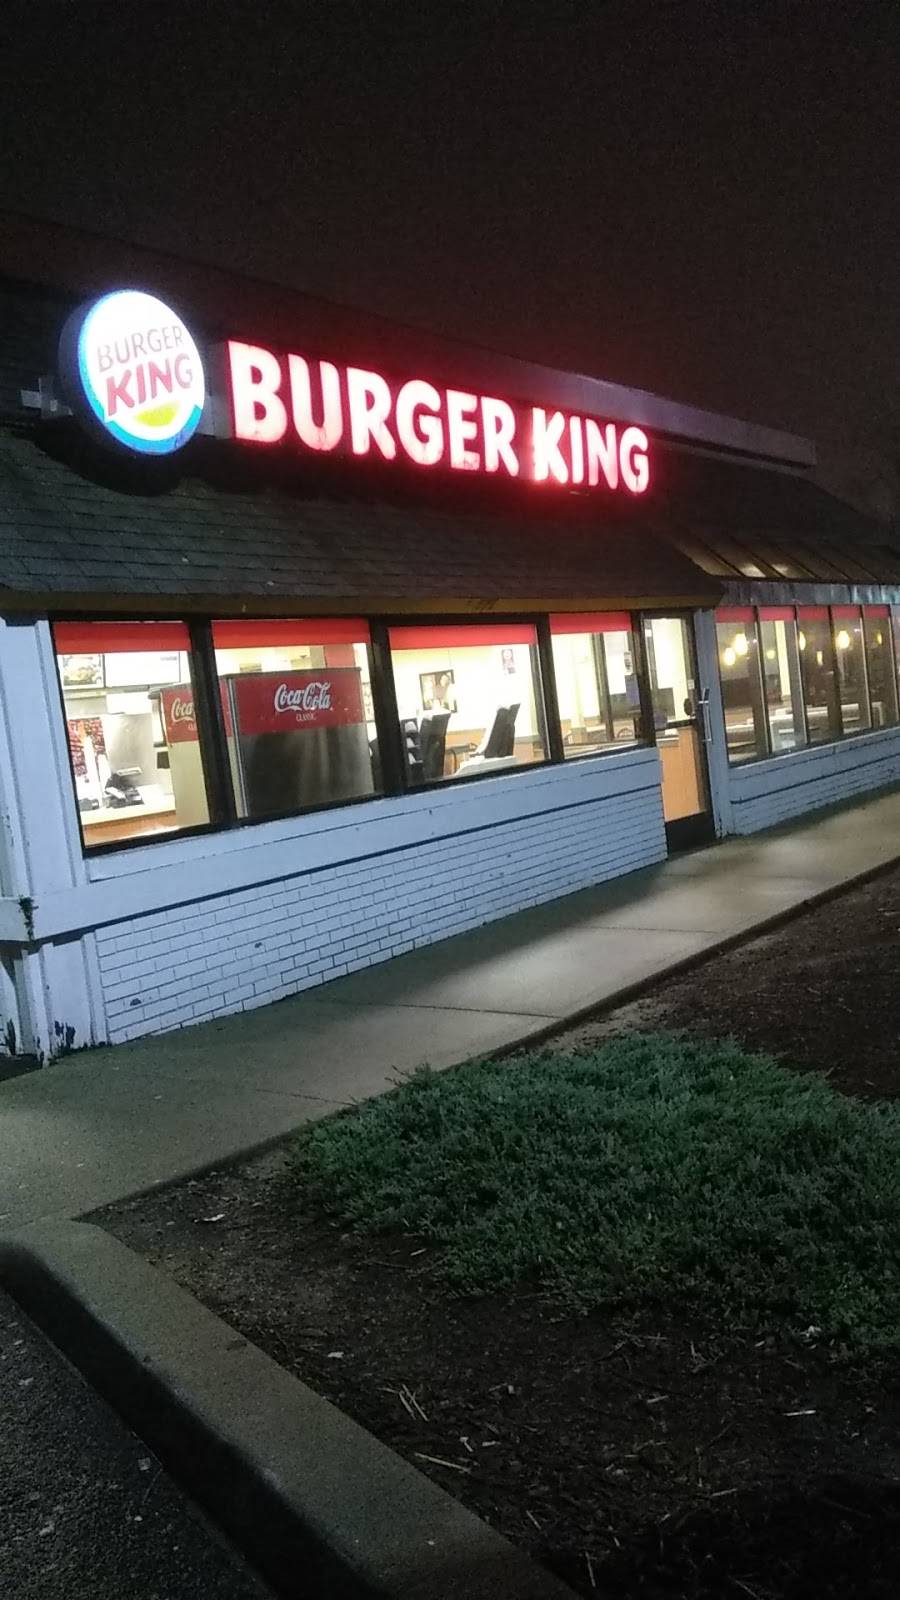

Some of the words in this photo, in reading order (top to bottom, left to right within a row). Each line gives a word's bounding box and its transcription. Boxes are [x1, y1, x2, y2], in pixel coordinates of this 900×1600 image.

[97, 325, 184, 373] BURGER
[106, 353, 194, 417] KING
[227, 340, 520, 478] BURGER
[531, 406, 650, 494] KING
[274, 682, 331, 713] Coca-Cola
